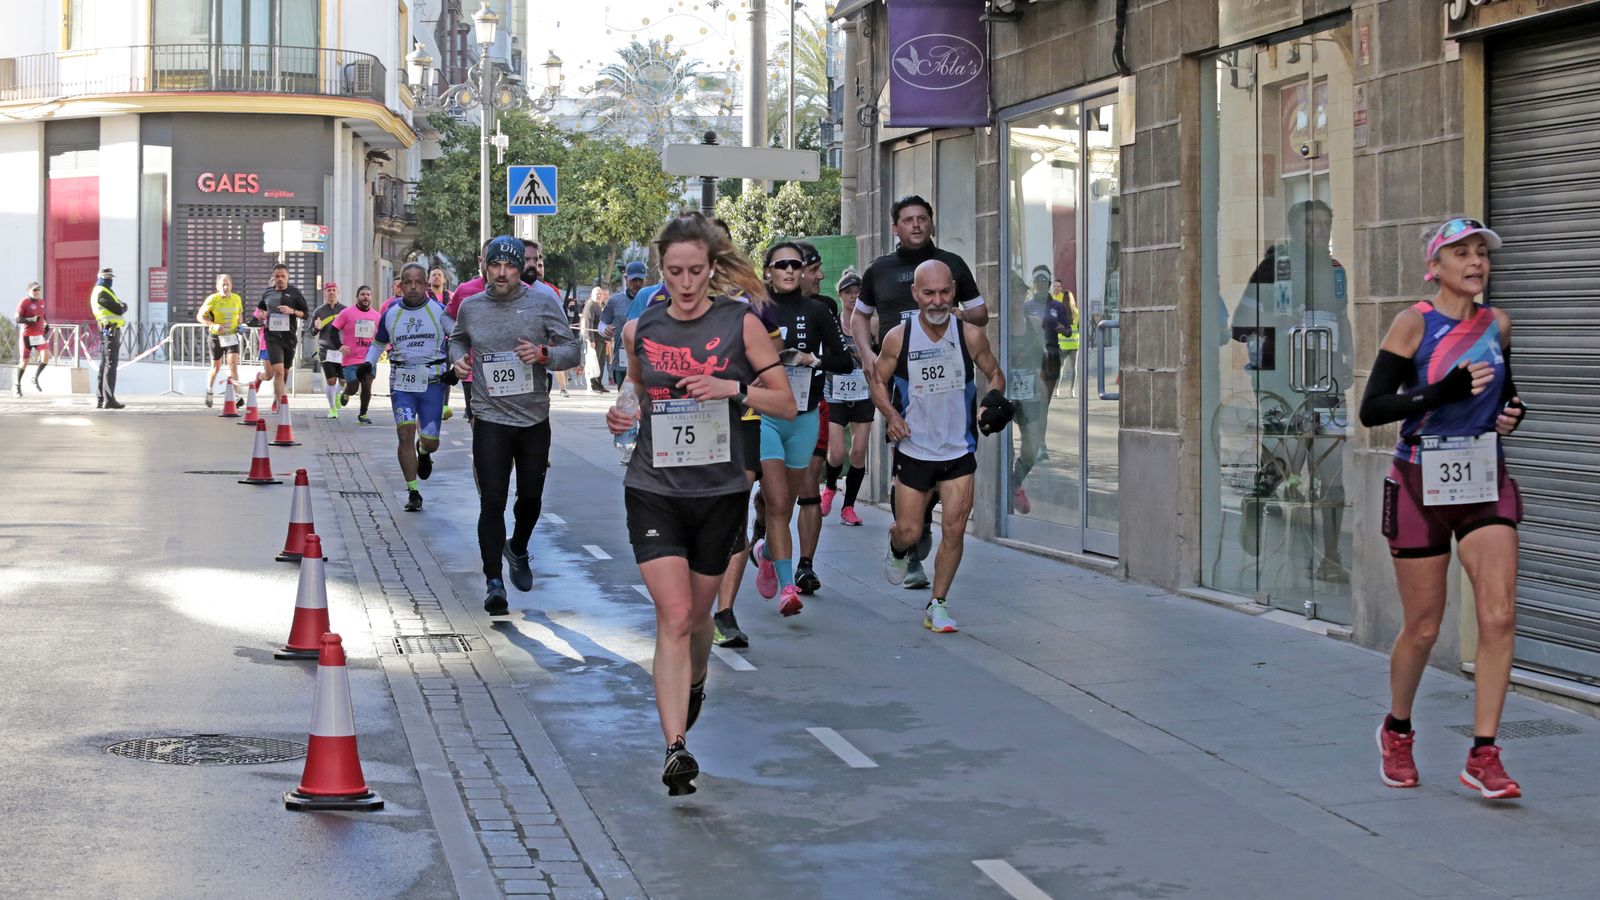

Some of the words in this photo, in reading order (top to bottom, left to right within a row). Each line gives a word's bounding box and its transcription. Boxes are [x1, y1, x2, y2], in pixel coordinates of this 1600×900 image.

[197, 172, 260, 193] GAES
[661, 351, 687, 361] FLY
[909, 352, 919, 360] XXV
[655, 360, 690, 371] MAD
[401, 373, 416, 383] 748
[493, 368, 515, 383] 829
[921, 365, 945, 381] 582
[840, 381, 857, 391] 212
[652, 403, 666, 412] XXV
[667, 413, 712, 421] MARGARITA
[672, 425, 696, 445] 75
[1423, 438, 1439, 449] XXV
[1439, 461, 1472, 483] 331
